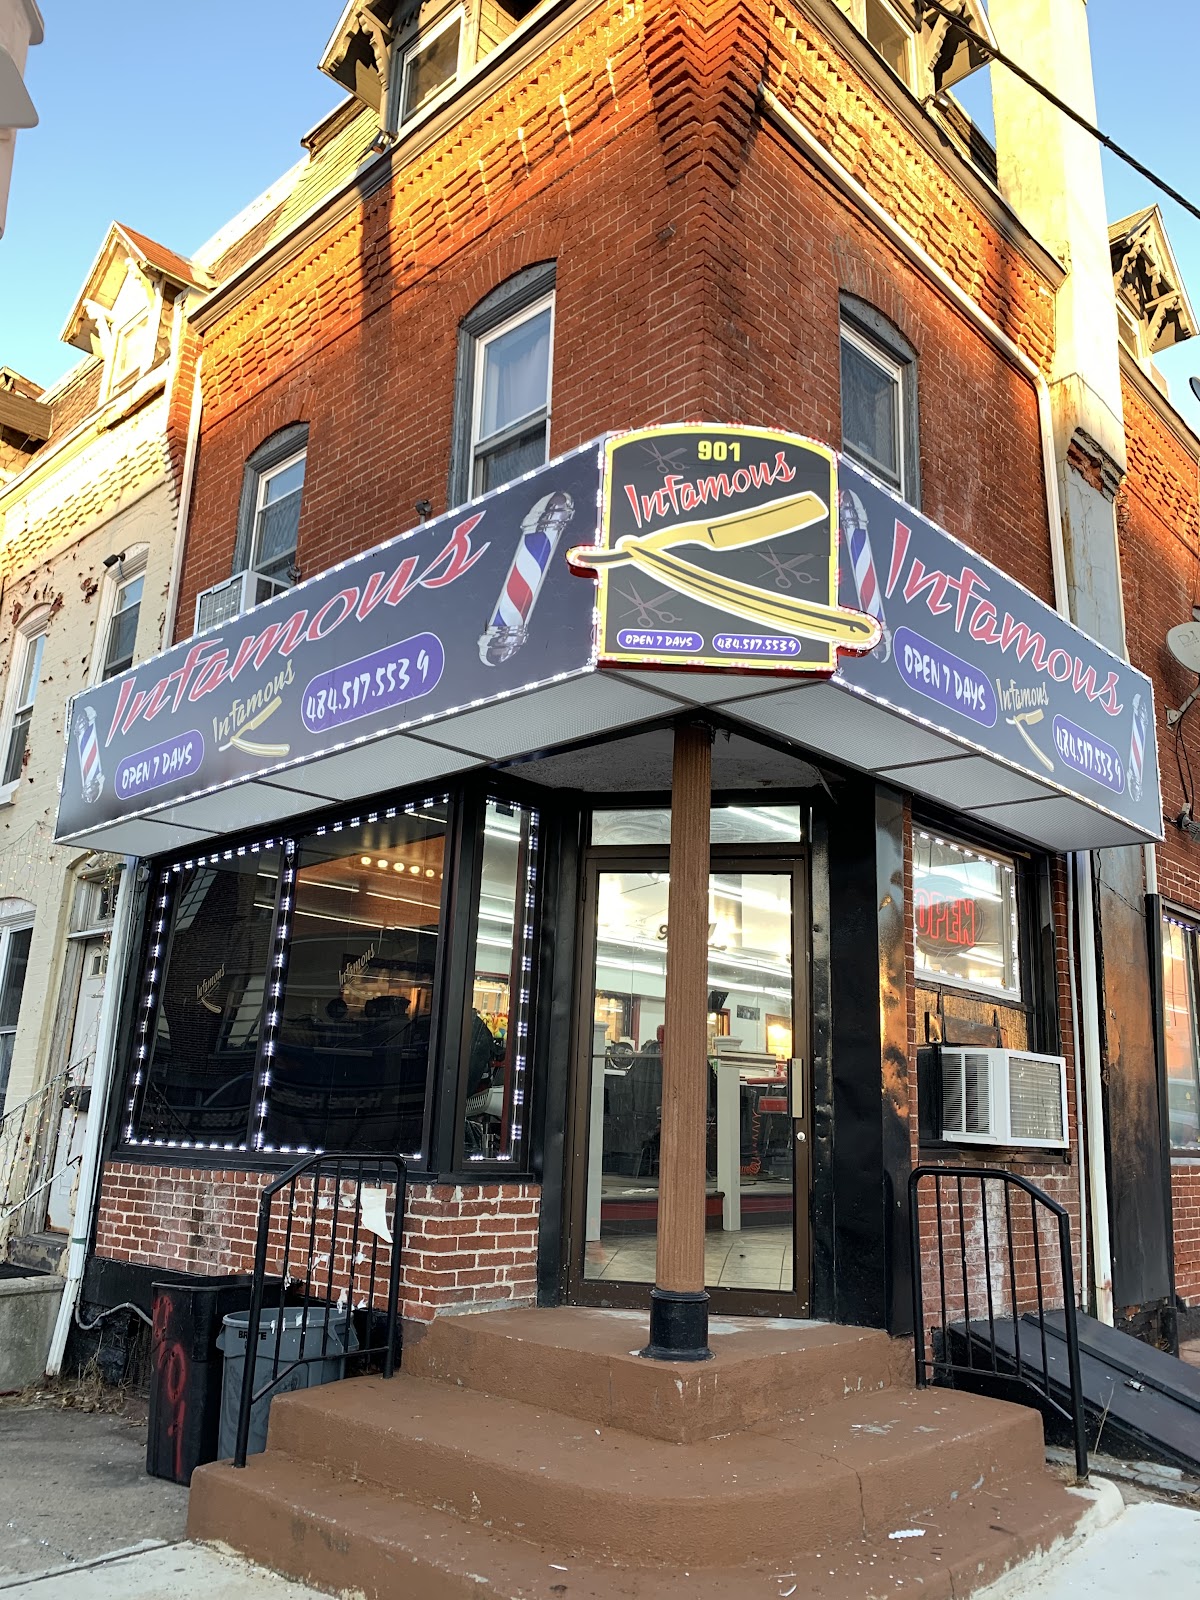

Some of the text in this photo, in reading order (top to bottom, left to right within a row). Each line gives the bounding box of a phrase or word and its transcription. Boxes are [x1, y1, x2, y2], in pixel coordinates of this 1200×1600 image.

[698, 440, 741, 462] 901
[624, 451, 797, 528] Infamous
[105, 510, 491, 748] Infamous
[625, 634, 693, 648] OPEN 7 DAYS
[884, 516, 1125, 716] Infamous
[716, 637, 797, 652] 484.517.5539
[904, 644, 986, 711] OPEN 7 DAYS
[121, 742, 193, 790] OPEN 7 DAYS
[913, 887, 975, 947] OPEN
[238, 1330, 267, 1341] BRE
